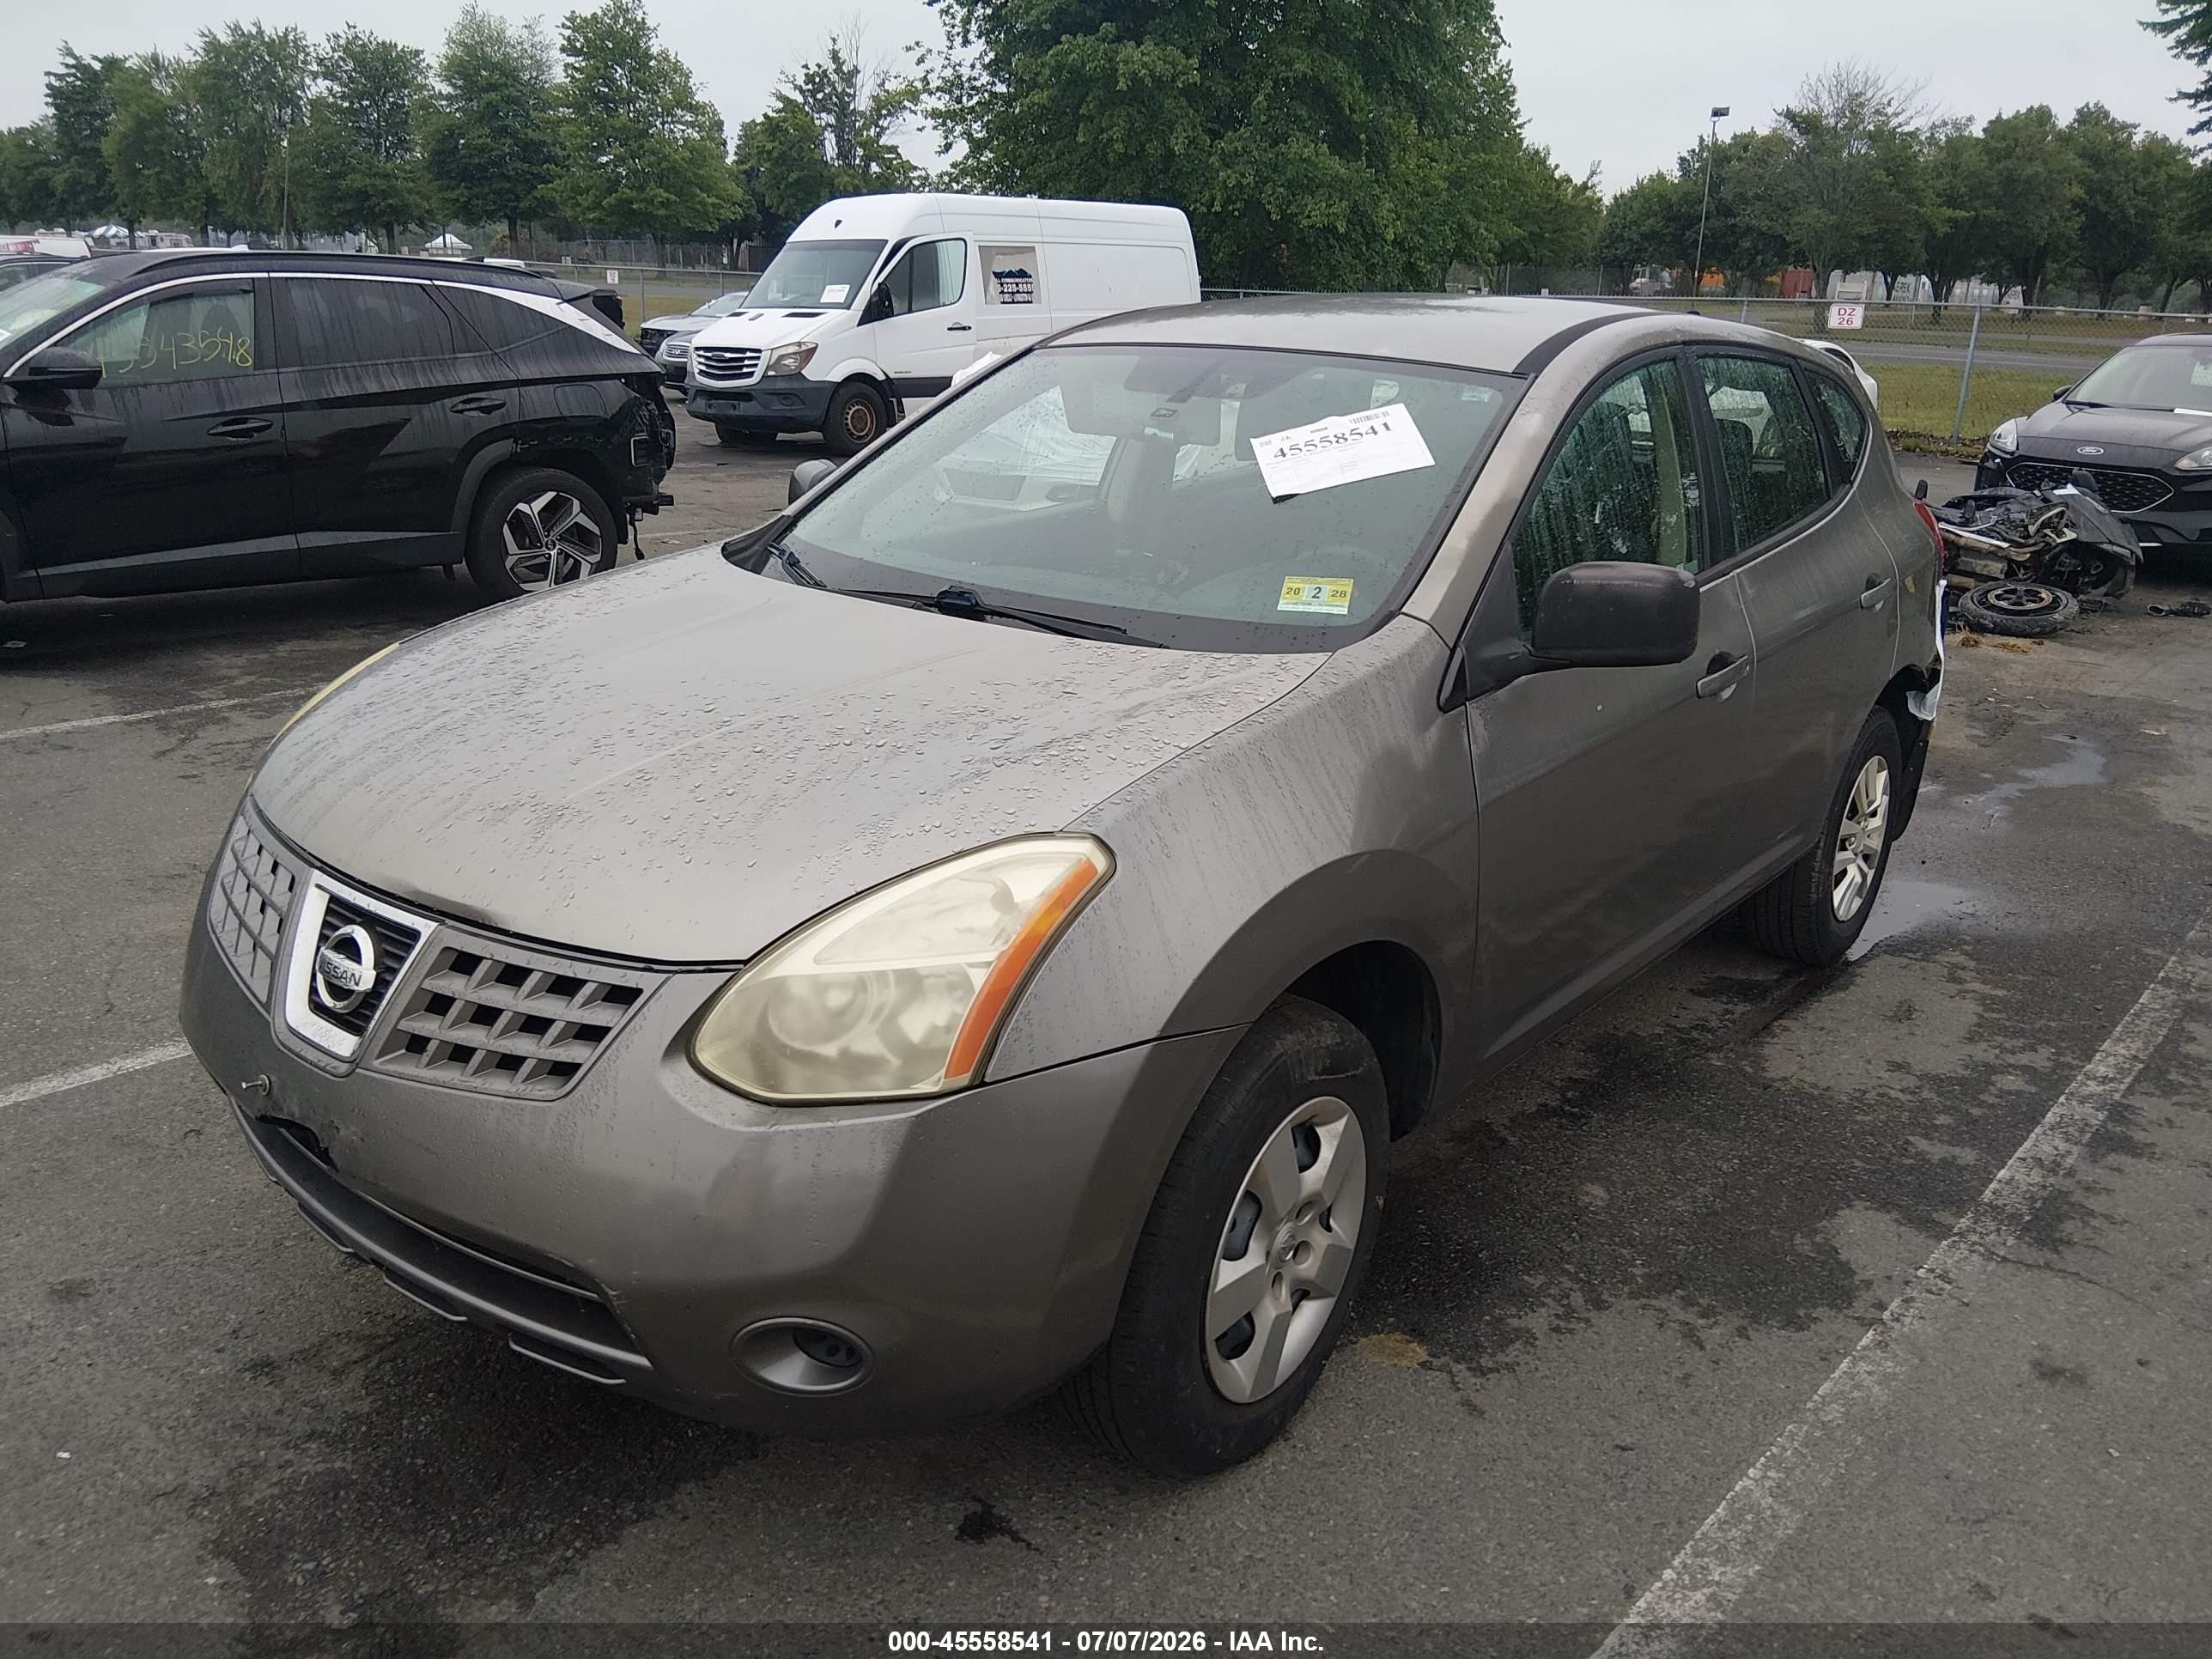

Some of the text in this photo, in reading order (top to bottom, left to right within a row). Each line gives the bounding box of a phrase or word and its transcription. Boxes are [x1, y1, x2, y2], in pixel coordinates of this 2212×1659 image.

[1838, 307, 1856, 316] DZ
[1838, 317, 1854, 325] 26
[1273, 421, 1394, 459] 45558541
[1285, 586, 1347, 599] 20 2 28
